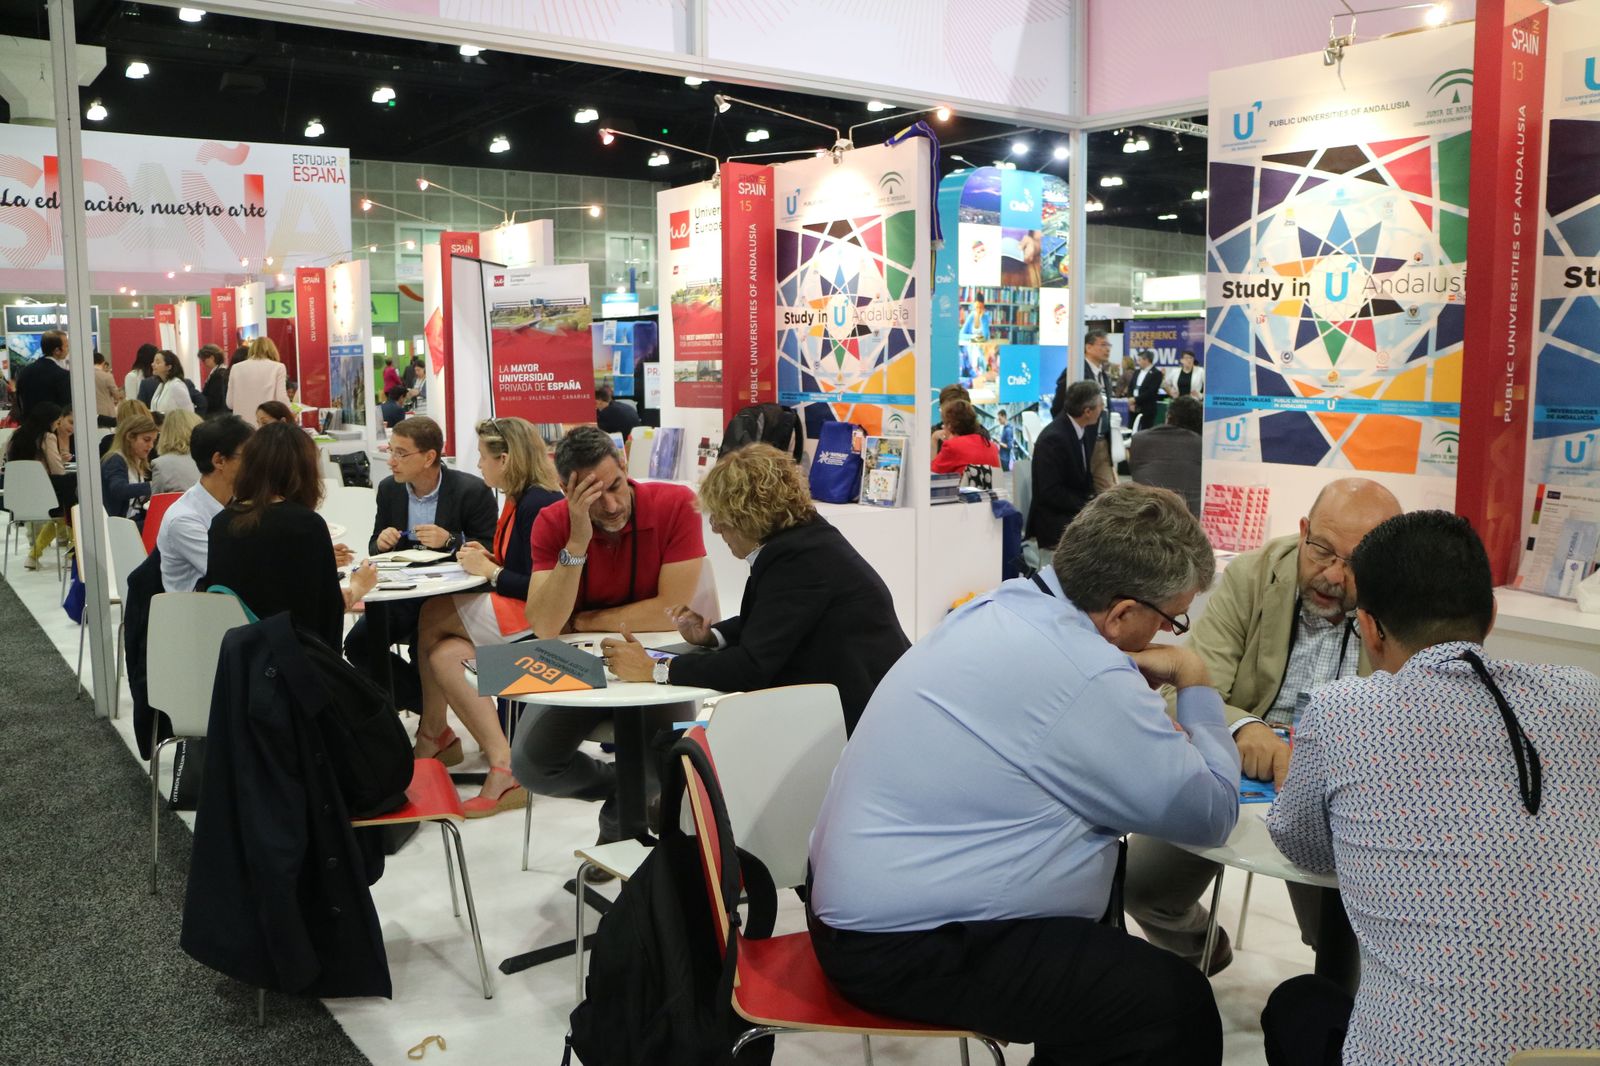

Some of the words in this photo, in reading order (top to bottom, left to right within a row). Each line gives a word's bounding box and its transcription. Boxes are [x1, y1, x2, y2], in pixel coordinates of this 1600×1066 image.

[1511, 28, 1540, 56] SPAIN
[1511, 61, 1525, 82] 13
[1268, 117, 1296, 128] PUBLIC
[1297, 110, 1349, 124] UNIVERSITIES
[1351, 107, 1362, 116] OF
[1363, 100, 1411, 114] ANDALUSIA
[292, 154, 337, 166] ESTUDIAR
[1514, 104, 1527, 208] ANDALUSIA
[738, 182, 767, 196] SPAIN
[0, 188, 30, 208] La
[35, 191, 144, 216] edación,
[151, 200, 224, 217] nuestro
[228, 203, 268, 218] arte
[740, 199, 753, 212] 15
[1512, 212, 1522, 235] OF
[451, 244, 474, 254] SPAIN
[749, 223, 757, 281] ANDALUSIA
[302, 276, 320, 284] SPAIN
[1222, 278, 1284, 300] Study
[1292, 277, 1310, 297] in
[1563, 266, 1600, 289] St
[750, 284, 758, 297] OF
[1507, 241, 1521, 356] UNIVERSITIES
[16, 314, 57, 325] ICELAND
[784, 310, 814, 326] Study
[818, 310, 828, 323] in
[852, 304, 909, 321] Andalusia
[750, 299, 758, 365] UNIVERSITIES
[1130, 330, 1177, 340] EXPERIENCE
[499, 364, 509, 374] LA
[510, 363, 539, 373] MAYOR
[499, 372, 554, 383] UNIVERSIDAD
[500, 382, 533, 392] PRIVADA
[535, 382, 546, 391] DE
[547, 379, 581, 391] ESPAÑA
[750, 368, 759, 403] PUBLIC
[1504, 361, 1515, 423] PUBLIC
[529, 393, 555, 401] VALENCIA
[514, 656, 562, 681] BGU
